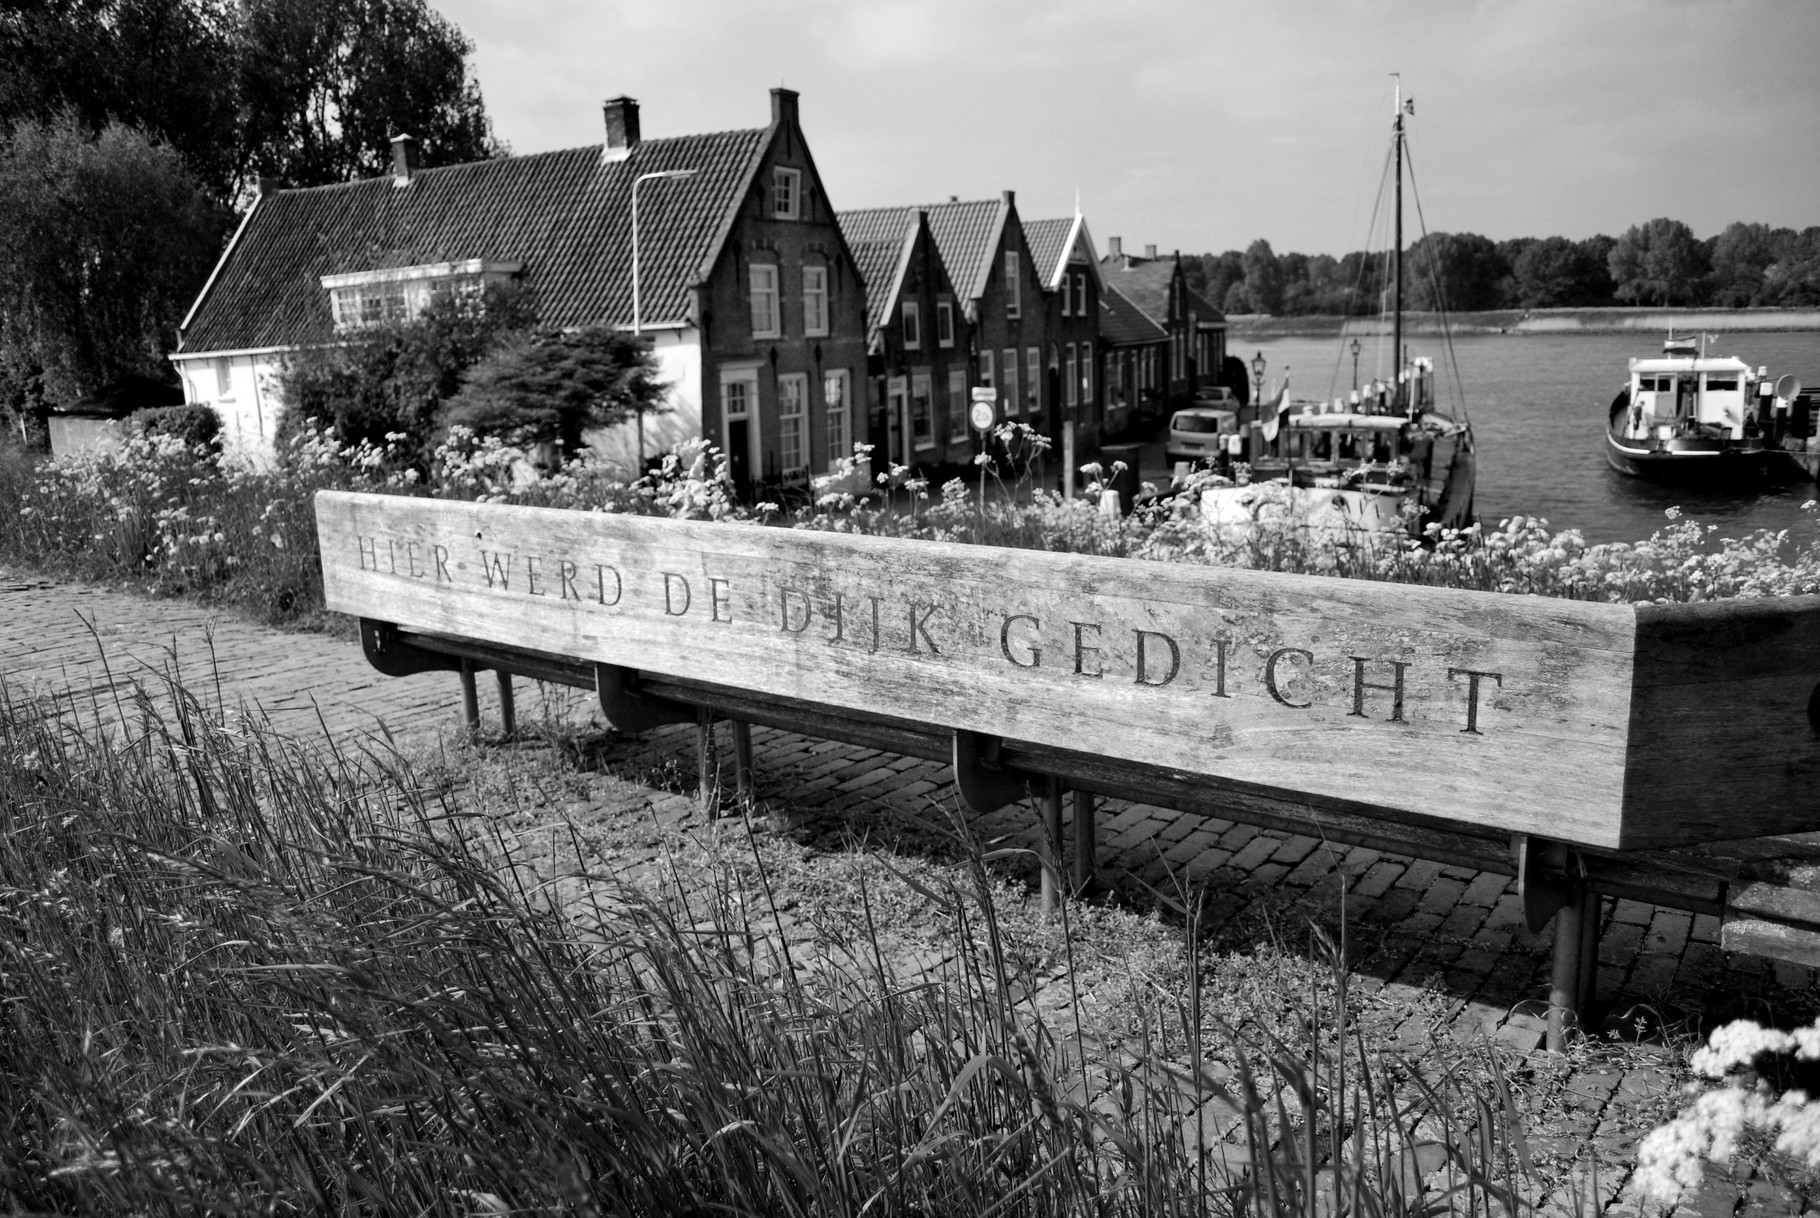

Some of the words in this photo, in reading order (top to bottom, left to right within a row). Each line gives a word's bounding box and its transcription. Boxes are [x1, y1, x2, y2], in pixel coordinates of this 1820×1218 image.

[357, 535, 454, 583] HIER
[480, 549, 623, 606] WERD
[660, 571, 733, 624] DE
[780, 586, 943, 656] DIJK
[1000, 614, 1504, 736] GEDICHT
